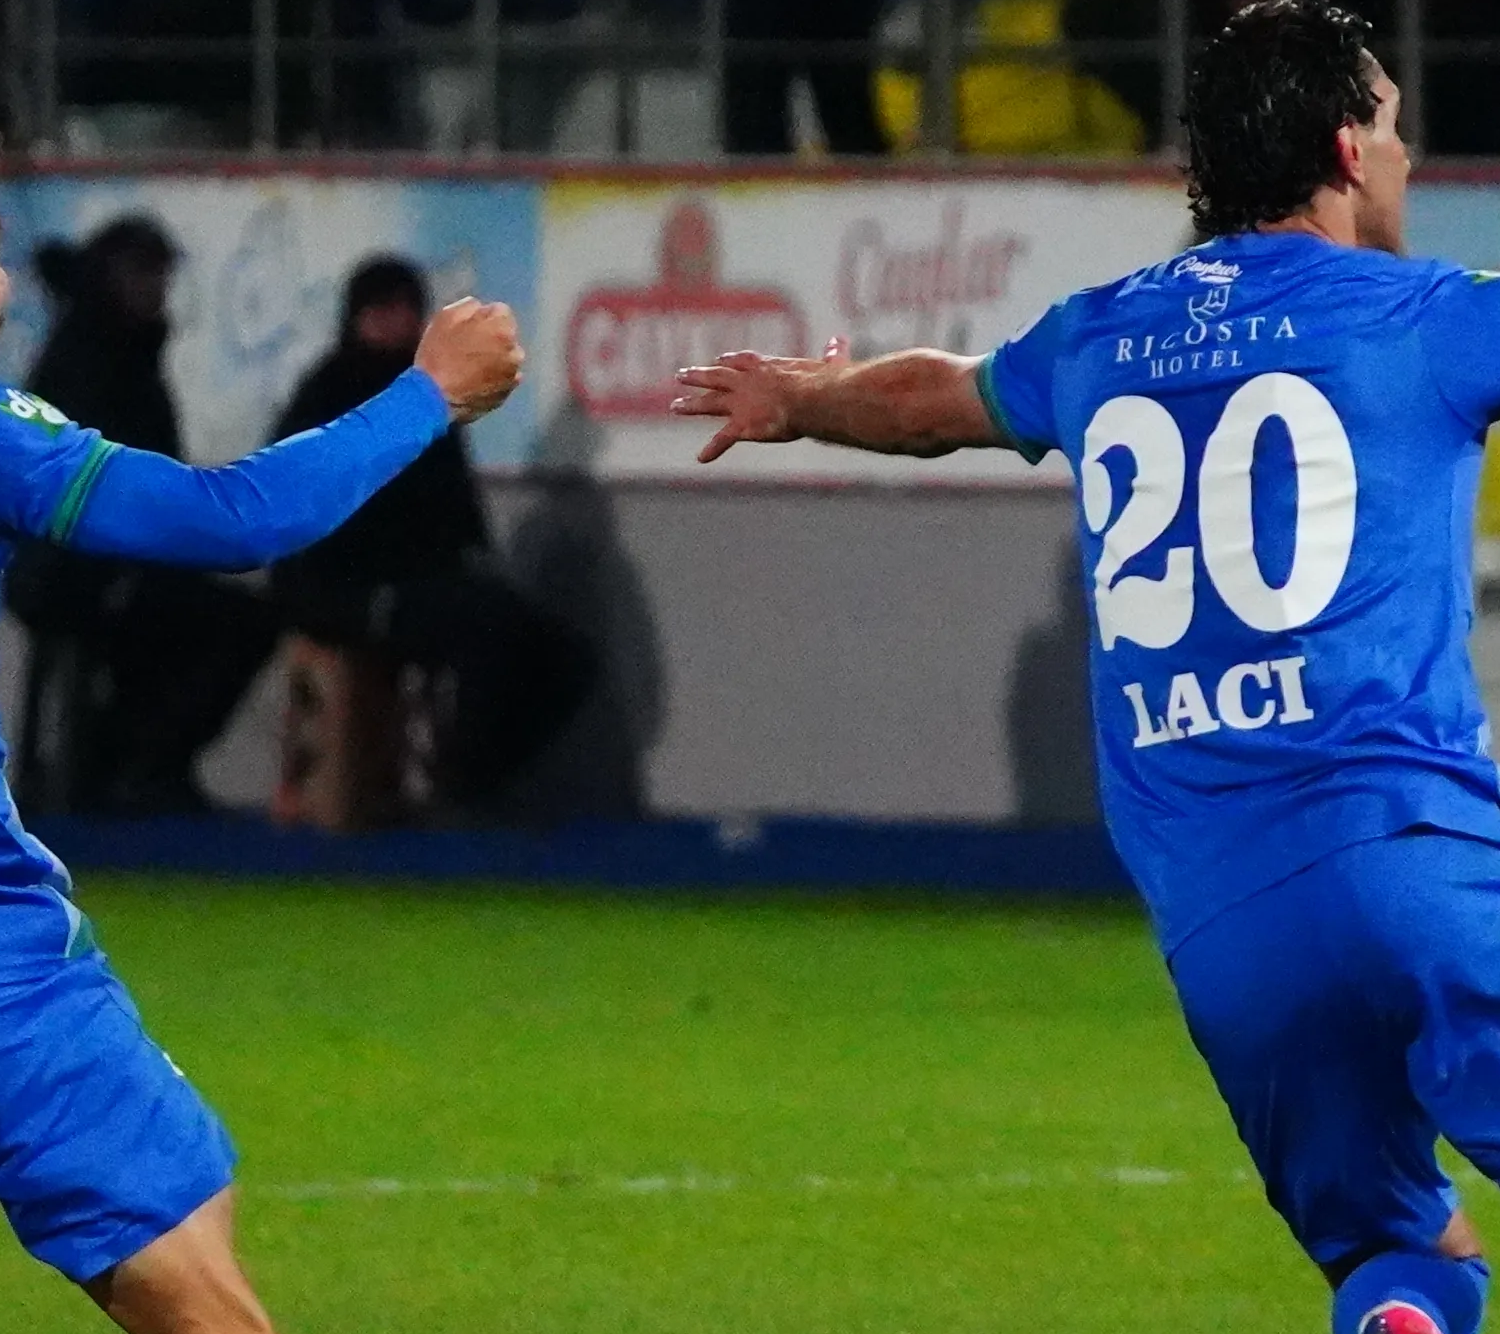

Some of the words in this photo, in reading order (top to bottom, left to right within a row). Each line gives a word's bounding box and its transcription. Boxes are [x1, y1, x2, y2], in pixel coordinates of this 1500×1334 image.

[1115, 315, 1297, 363] RICOSTA
[1151, 349, 1243, 380] HOTEL
[1081, 372, 1358, 652] 20
[1122, 656, 1314, 749] LACI
